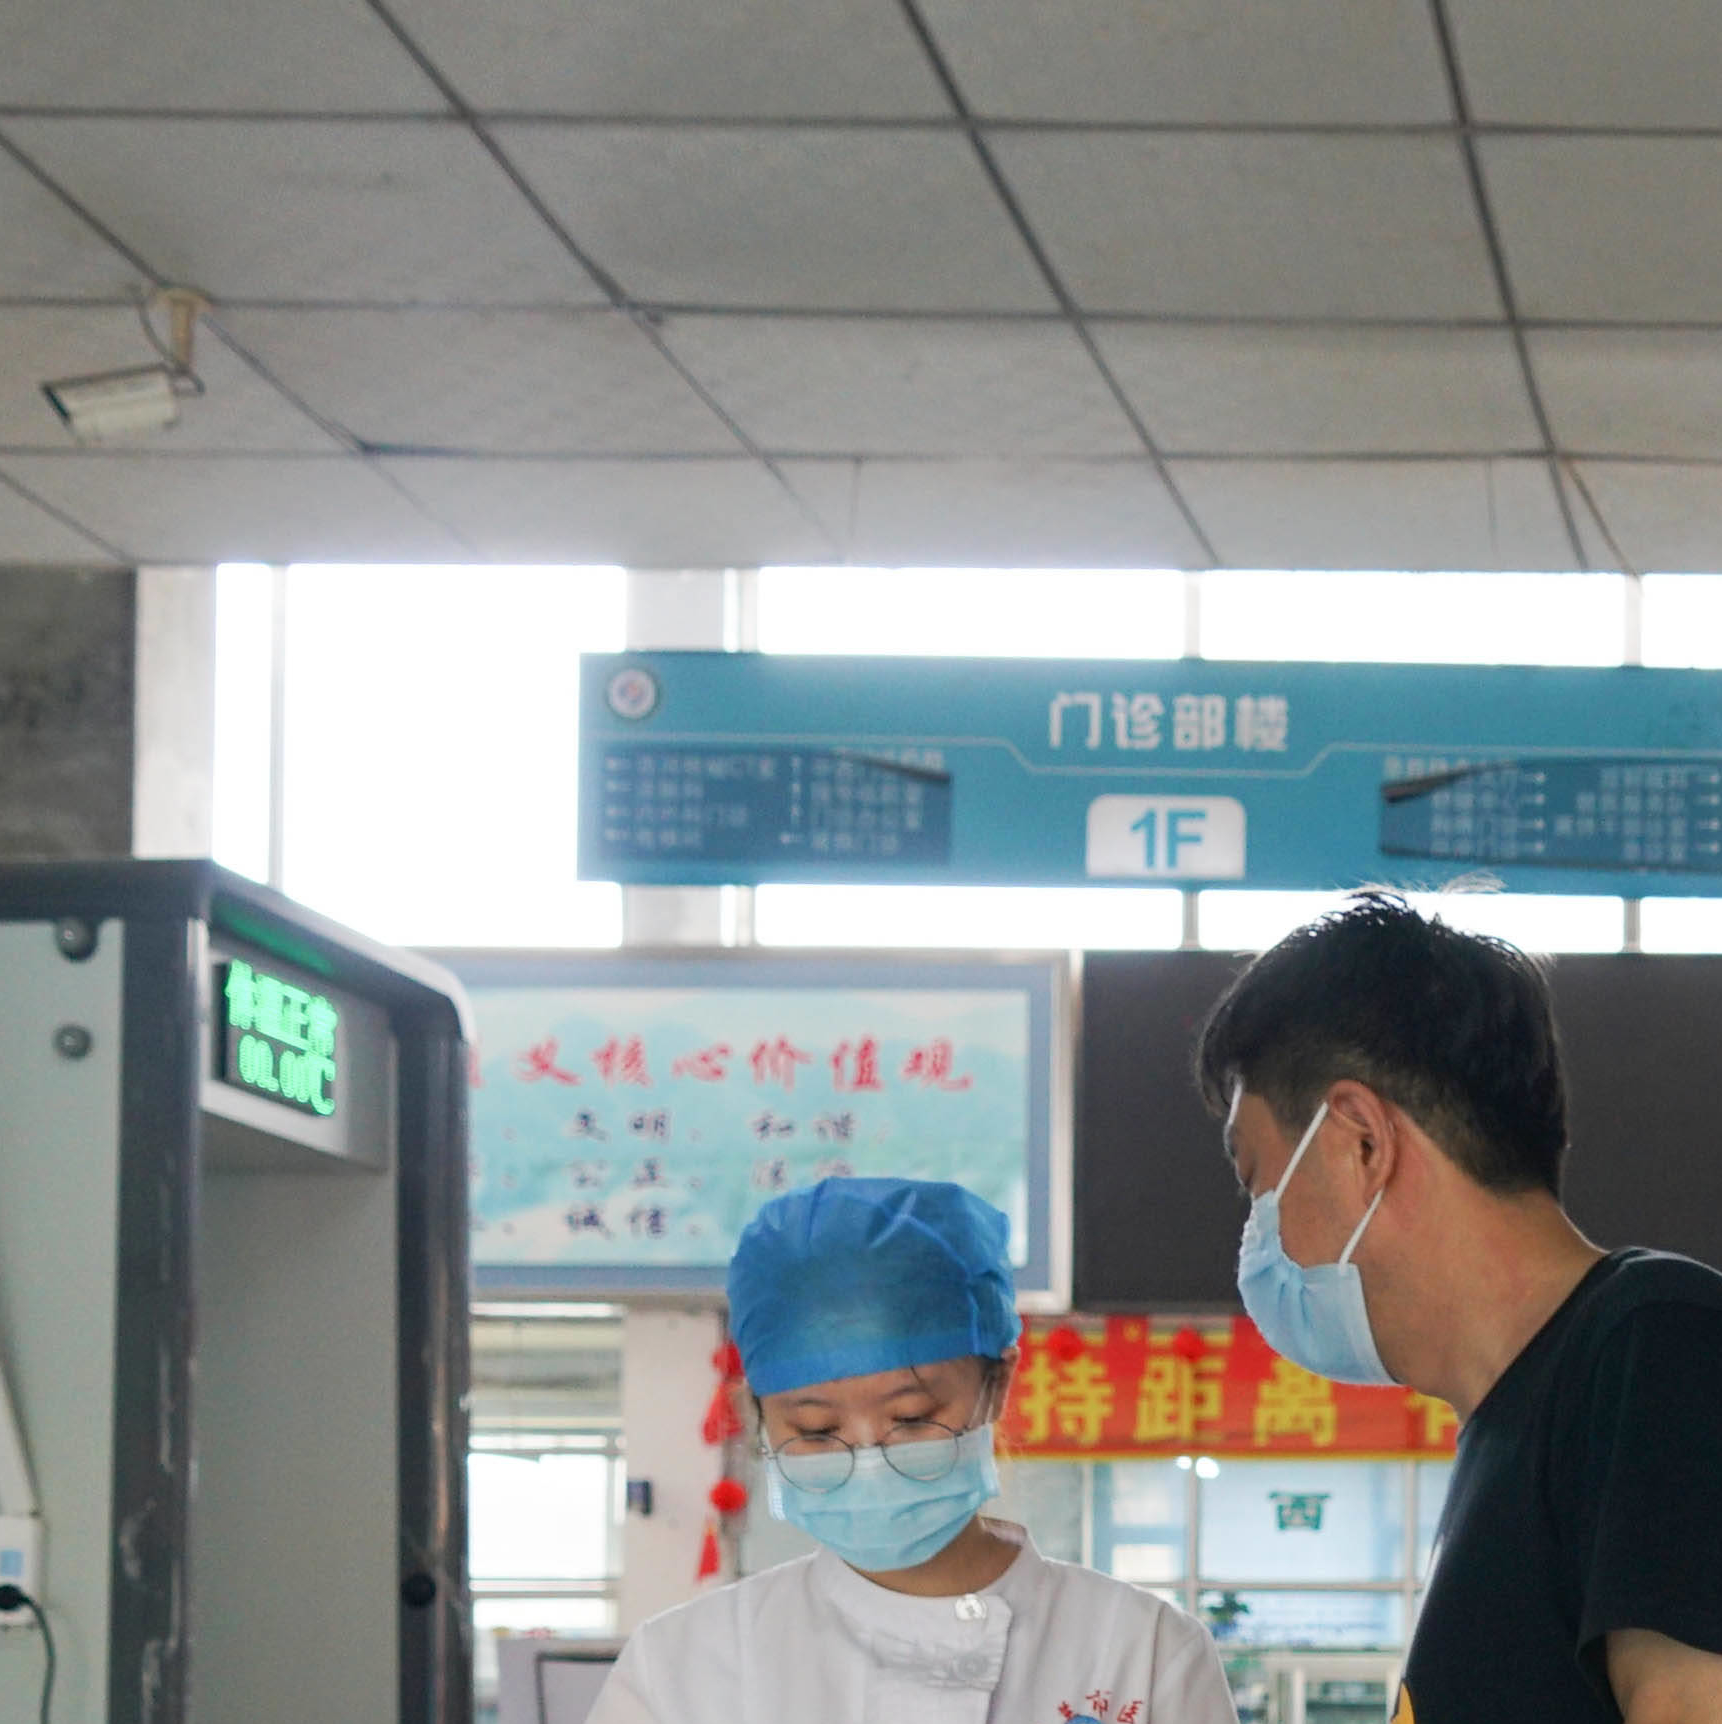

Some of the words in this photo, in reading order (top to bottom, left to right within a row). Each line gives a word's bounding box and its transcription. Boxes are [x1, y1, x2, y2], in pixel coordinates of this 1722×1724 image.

[1050, 692, 1288, 751] 门诊部楼
[1130, 808, 1206, 869] 1F
[467, 1034, 975, 1093] 义核心价值观
[1018, 1352, 1459, 1448] 持距离
